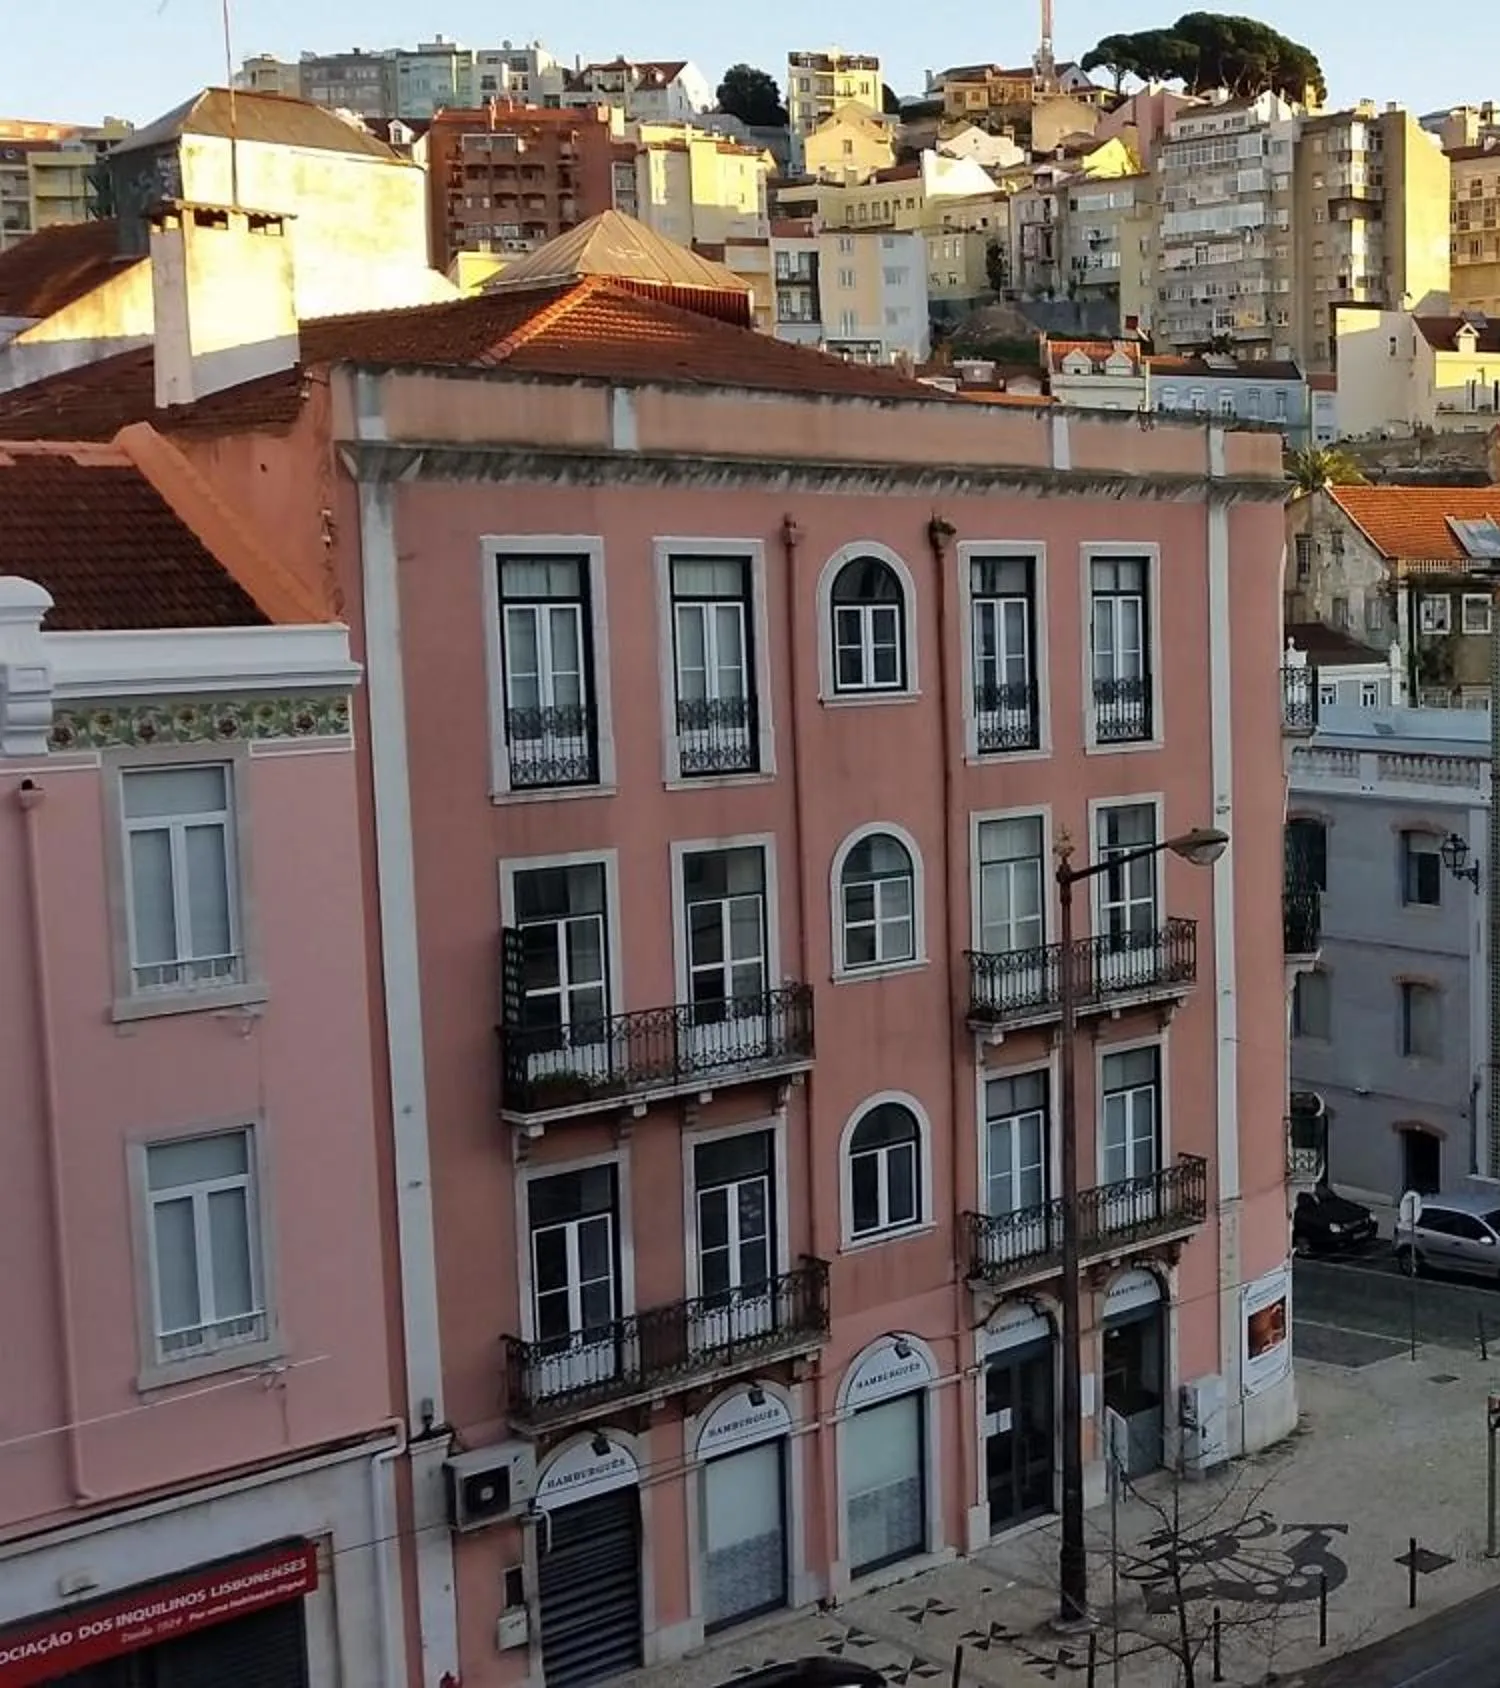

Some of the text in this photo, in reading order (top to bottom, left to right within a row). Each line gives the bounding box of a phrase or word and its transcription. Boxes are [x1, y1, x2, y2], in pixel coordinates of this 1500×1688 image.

[79, 1618, 113, 1640] DOS
[115, 1588, 207, 1627] INQUILINOS
[210, 1558, 307, 1597] LISBONENSES
